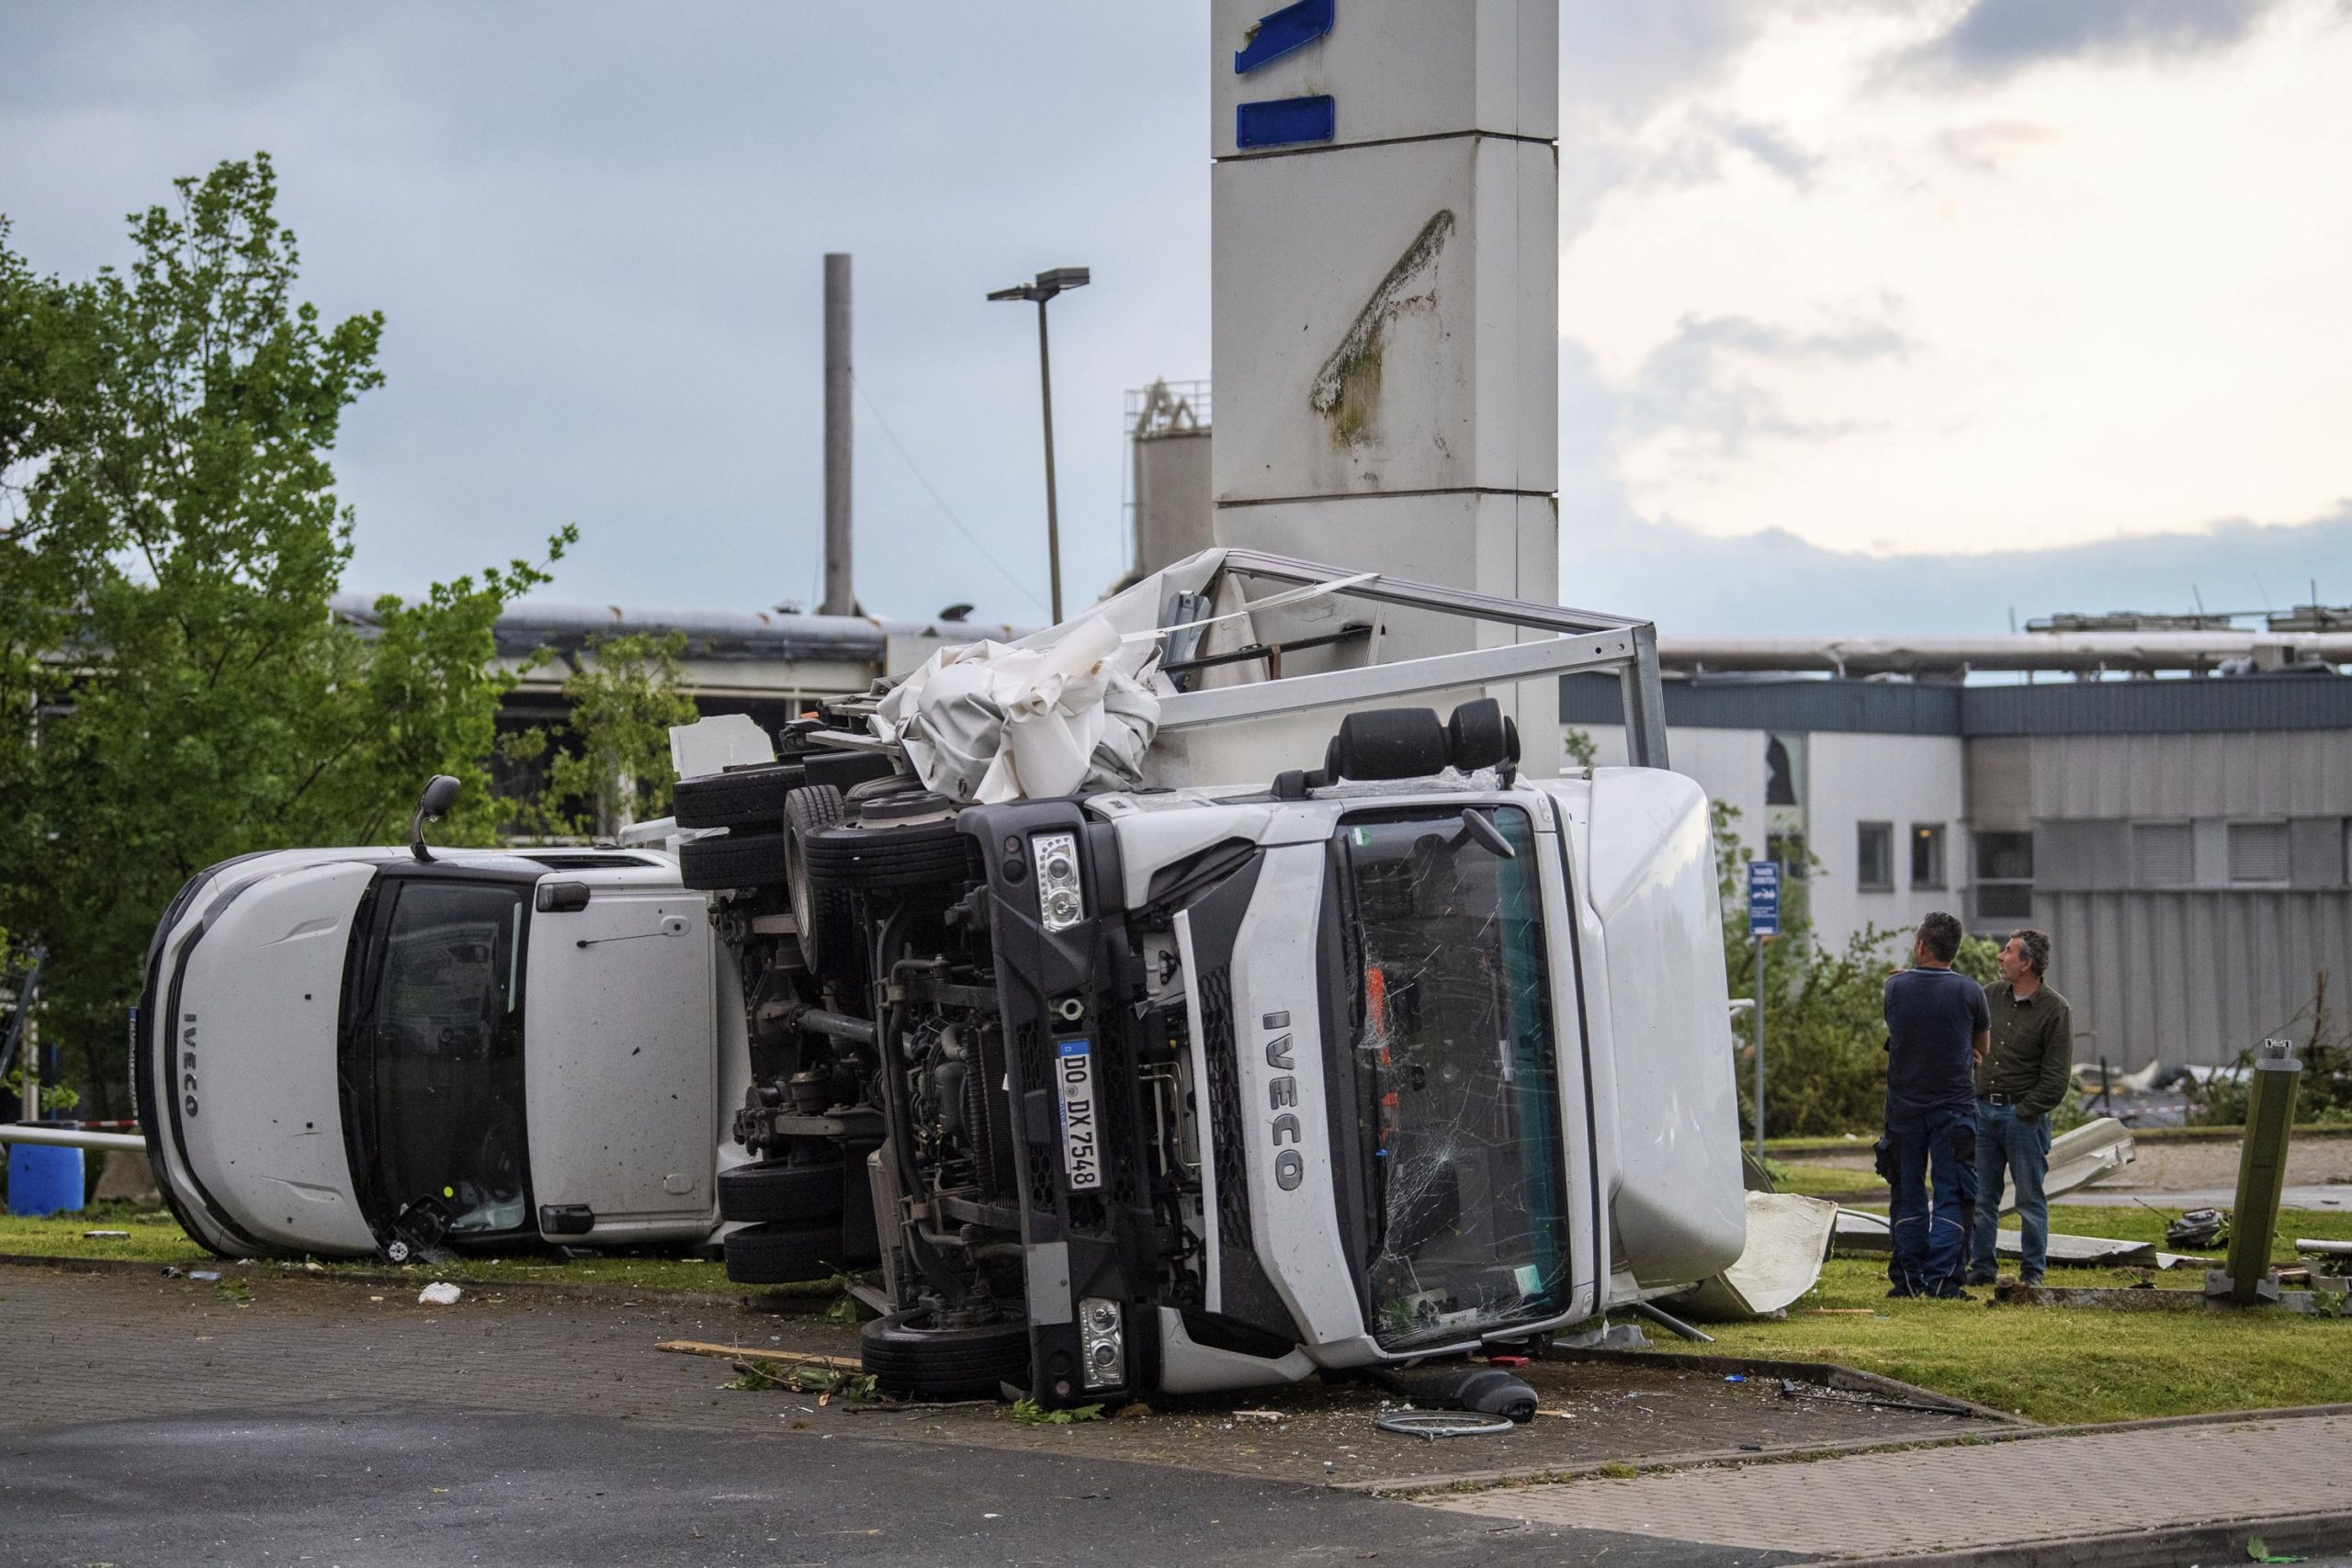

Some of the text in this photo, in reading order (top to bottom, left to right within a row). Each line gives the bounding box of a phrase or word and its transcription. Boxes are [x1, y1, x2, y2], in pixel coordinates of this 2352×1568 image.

[184, 1013, 198, 1117] IVECO
[1064, 1055, 1096, 1185] DO DX 7548
[1262, 1010, 1304, 1190] IVECO
